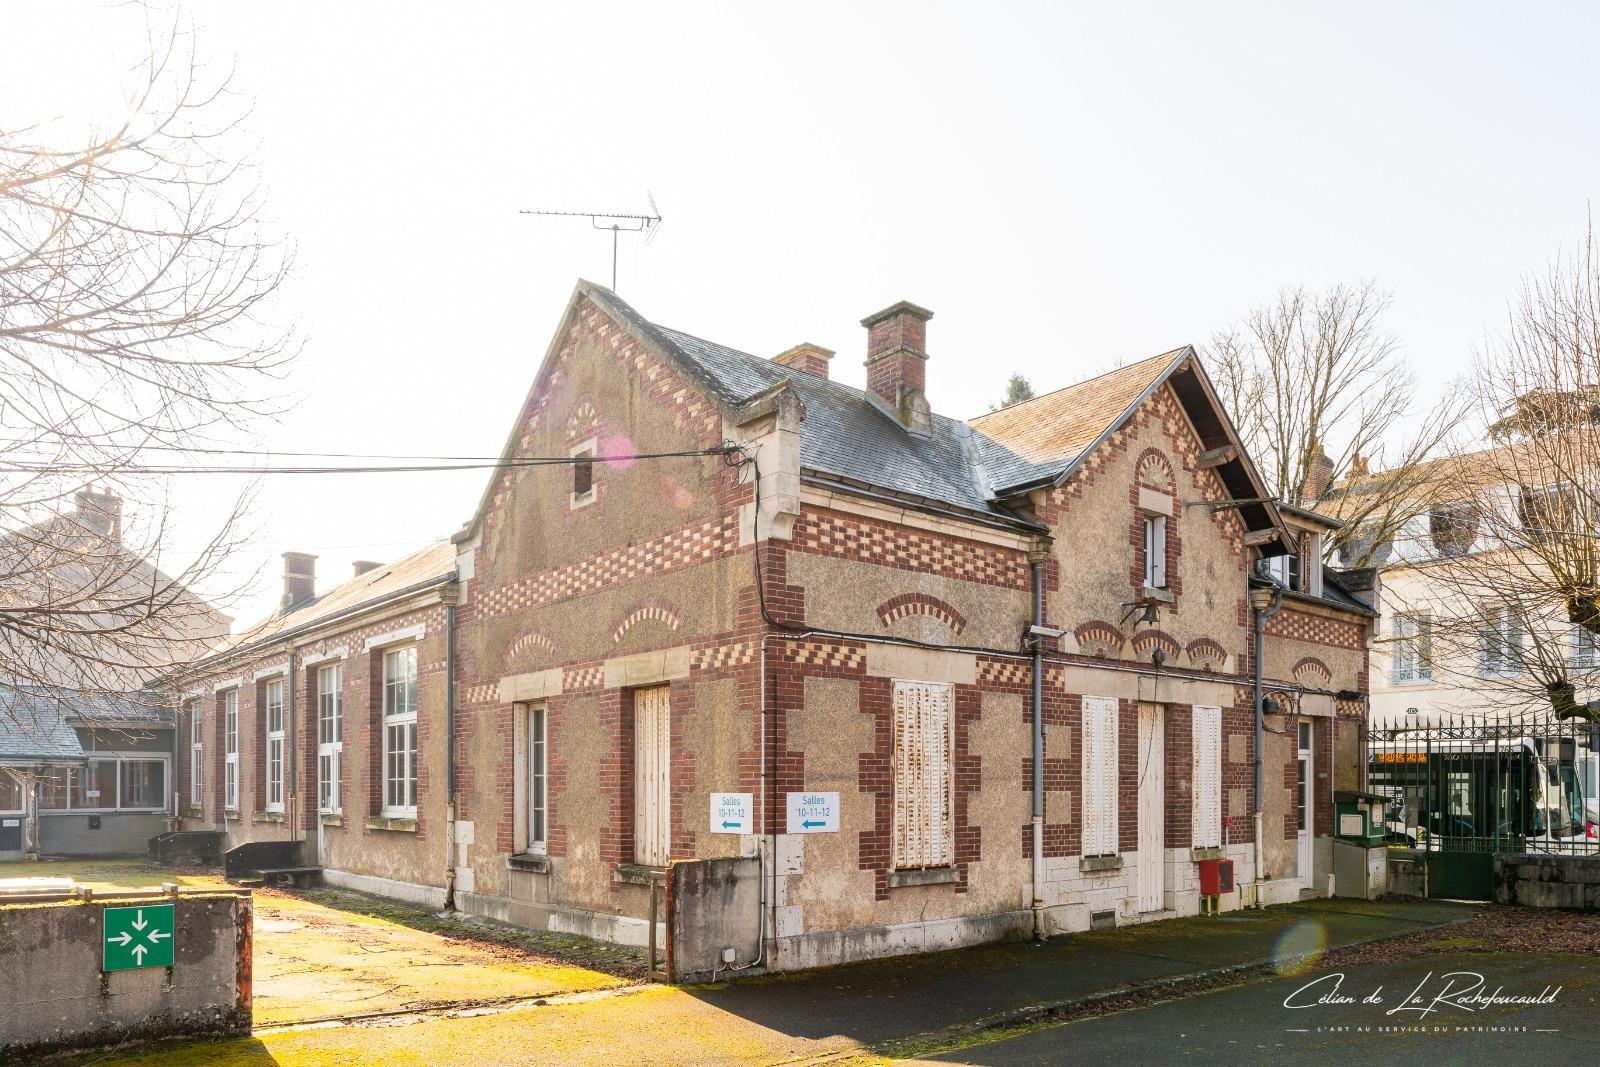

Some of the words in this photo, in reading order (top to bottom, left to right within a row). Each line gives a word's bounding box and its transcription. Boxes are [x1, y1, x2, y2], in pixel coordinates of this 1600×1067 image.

[722, 796, 741, 806] Salles
[802, 795, 825, 805] Salles
[718, 808, 745, 818] 10-11-12
[797, 807, 831, 817] 10-11-12
